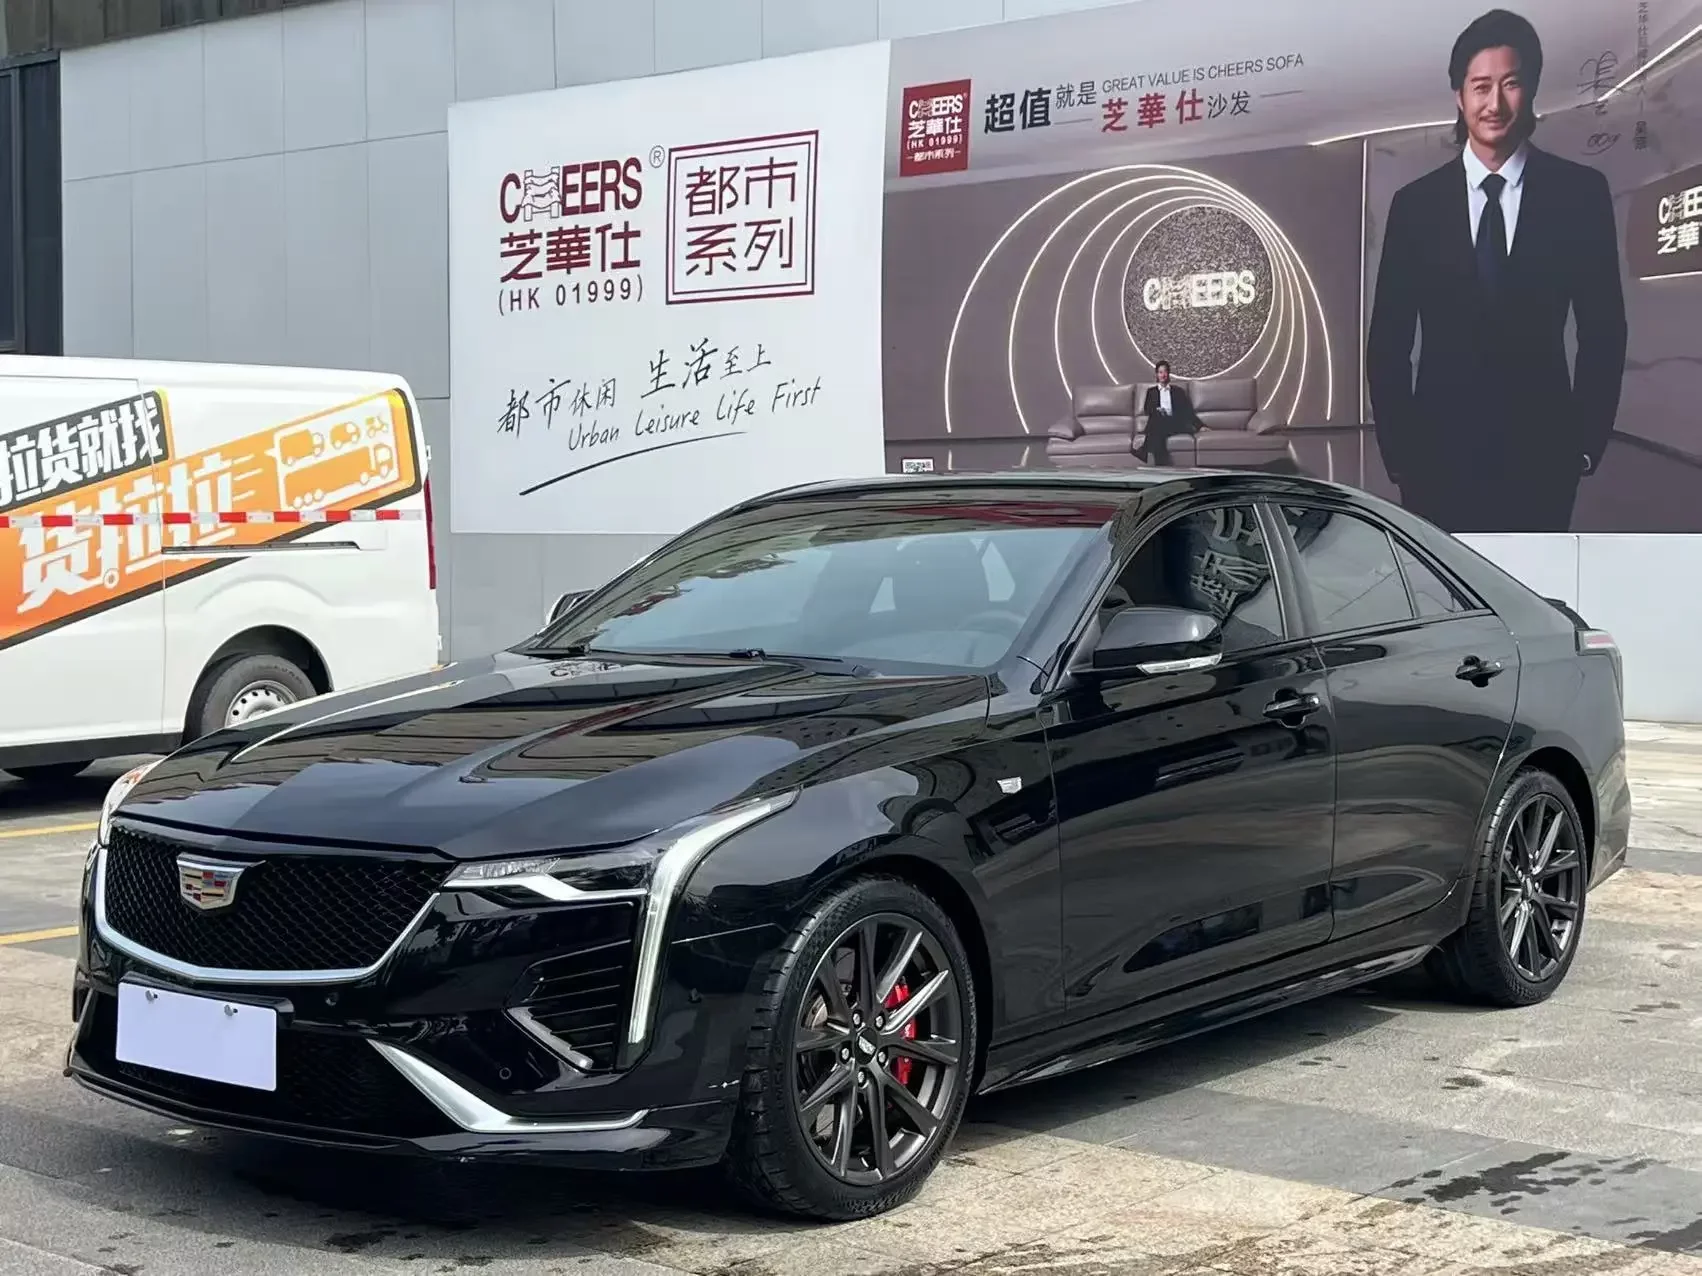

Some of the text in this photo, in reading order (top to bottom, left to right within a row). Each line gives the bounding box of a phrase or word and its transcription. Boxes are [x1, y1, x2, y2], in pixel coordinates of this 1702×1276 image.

[1101, 53, 1305, 94] GREAT VALUE IS CHEERS SOFA
[908, 116, 962, 139] 芝華仕
[686, 156, 798, 217] 都市
[500, 221, 642, 283] 芝華仕
[686, 217, 795, 277] 系列
[498, 274, 644, 317] (HK 01999)
[497, 337, 772, 440] 都市休闲 生活至上
[568, 376, 822, 451] Urban Leisure Life First
[16, 452, 236, 614] 货拉拉
